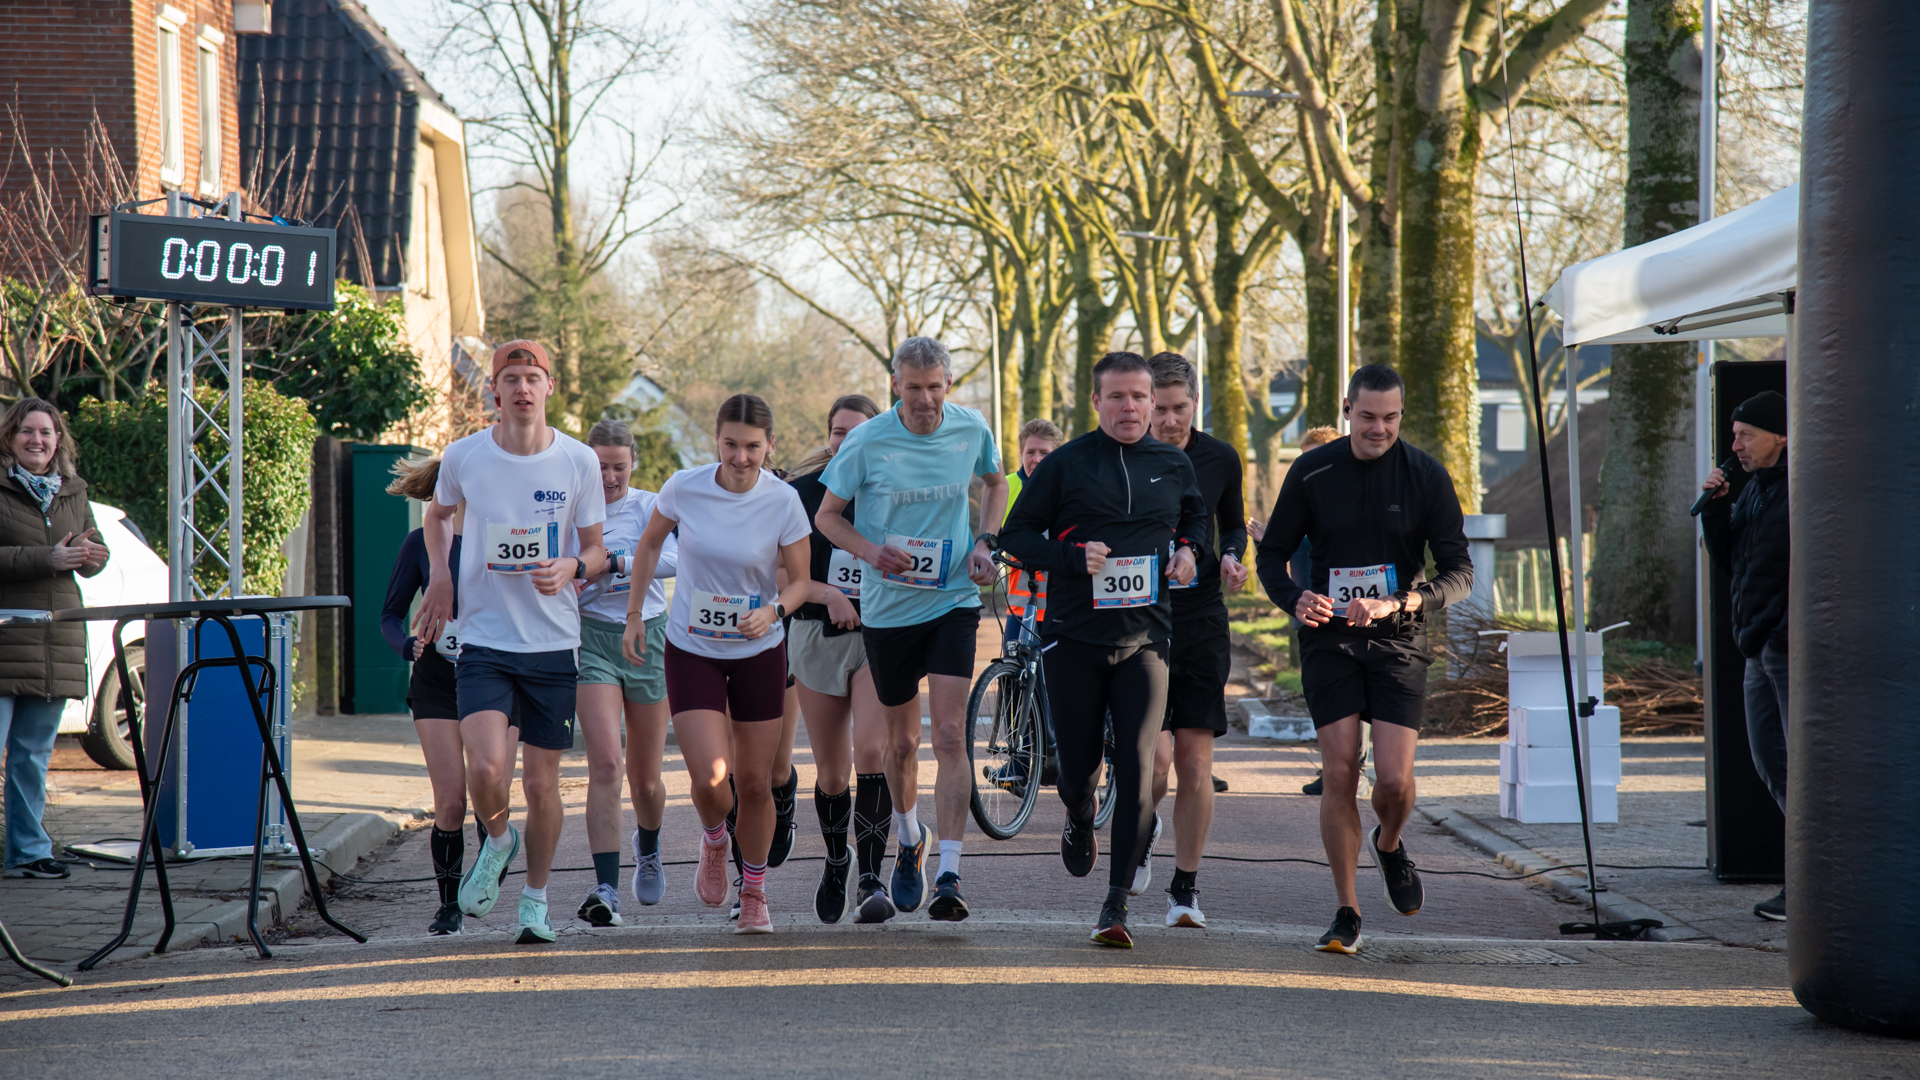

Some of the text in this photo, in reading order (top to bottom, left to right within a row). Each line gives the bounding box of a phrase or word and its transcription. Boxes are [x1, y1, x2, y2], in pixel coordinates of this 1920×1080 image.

[161, 237, 317, 286] 0:00:01
[545, 490, 567, 501] SDG
[497, 542, 540, 560] 305
[910, 555, 934, 573] 02
[837, 566, 862, 584] 35
[1103, 574, 1144, 593] 300
[1338, 584, 1380, 602] 304
[699, 608, 738, 628] 351
[445, 635, 458, 650] 3
